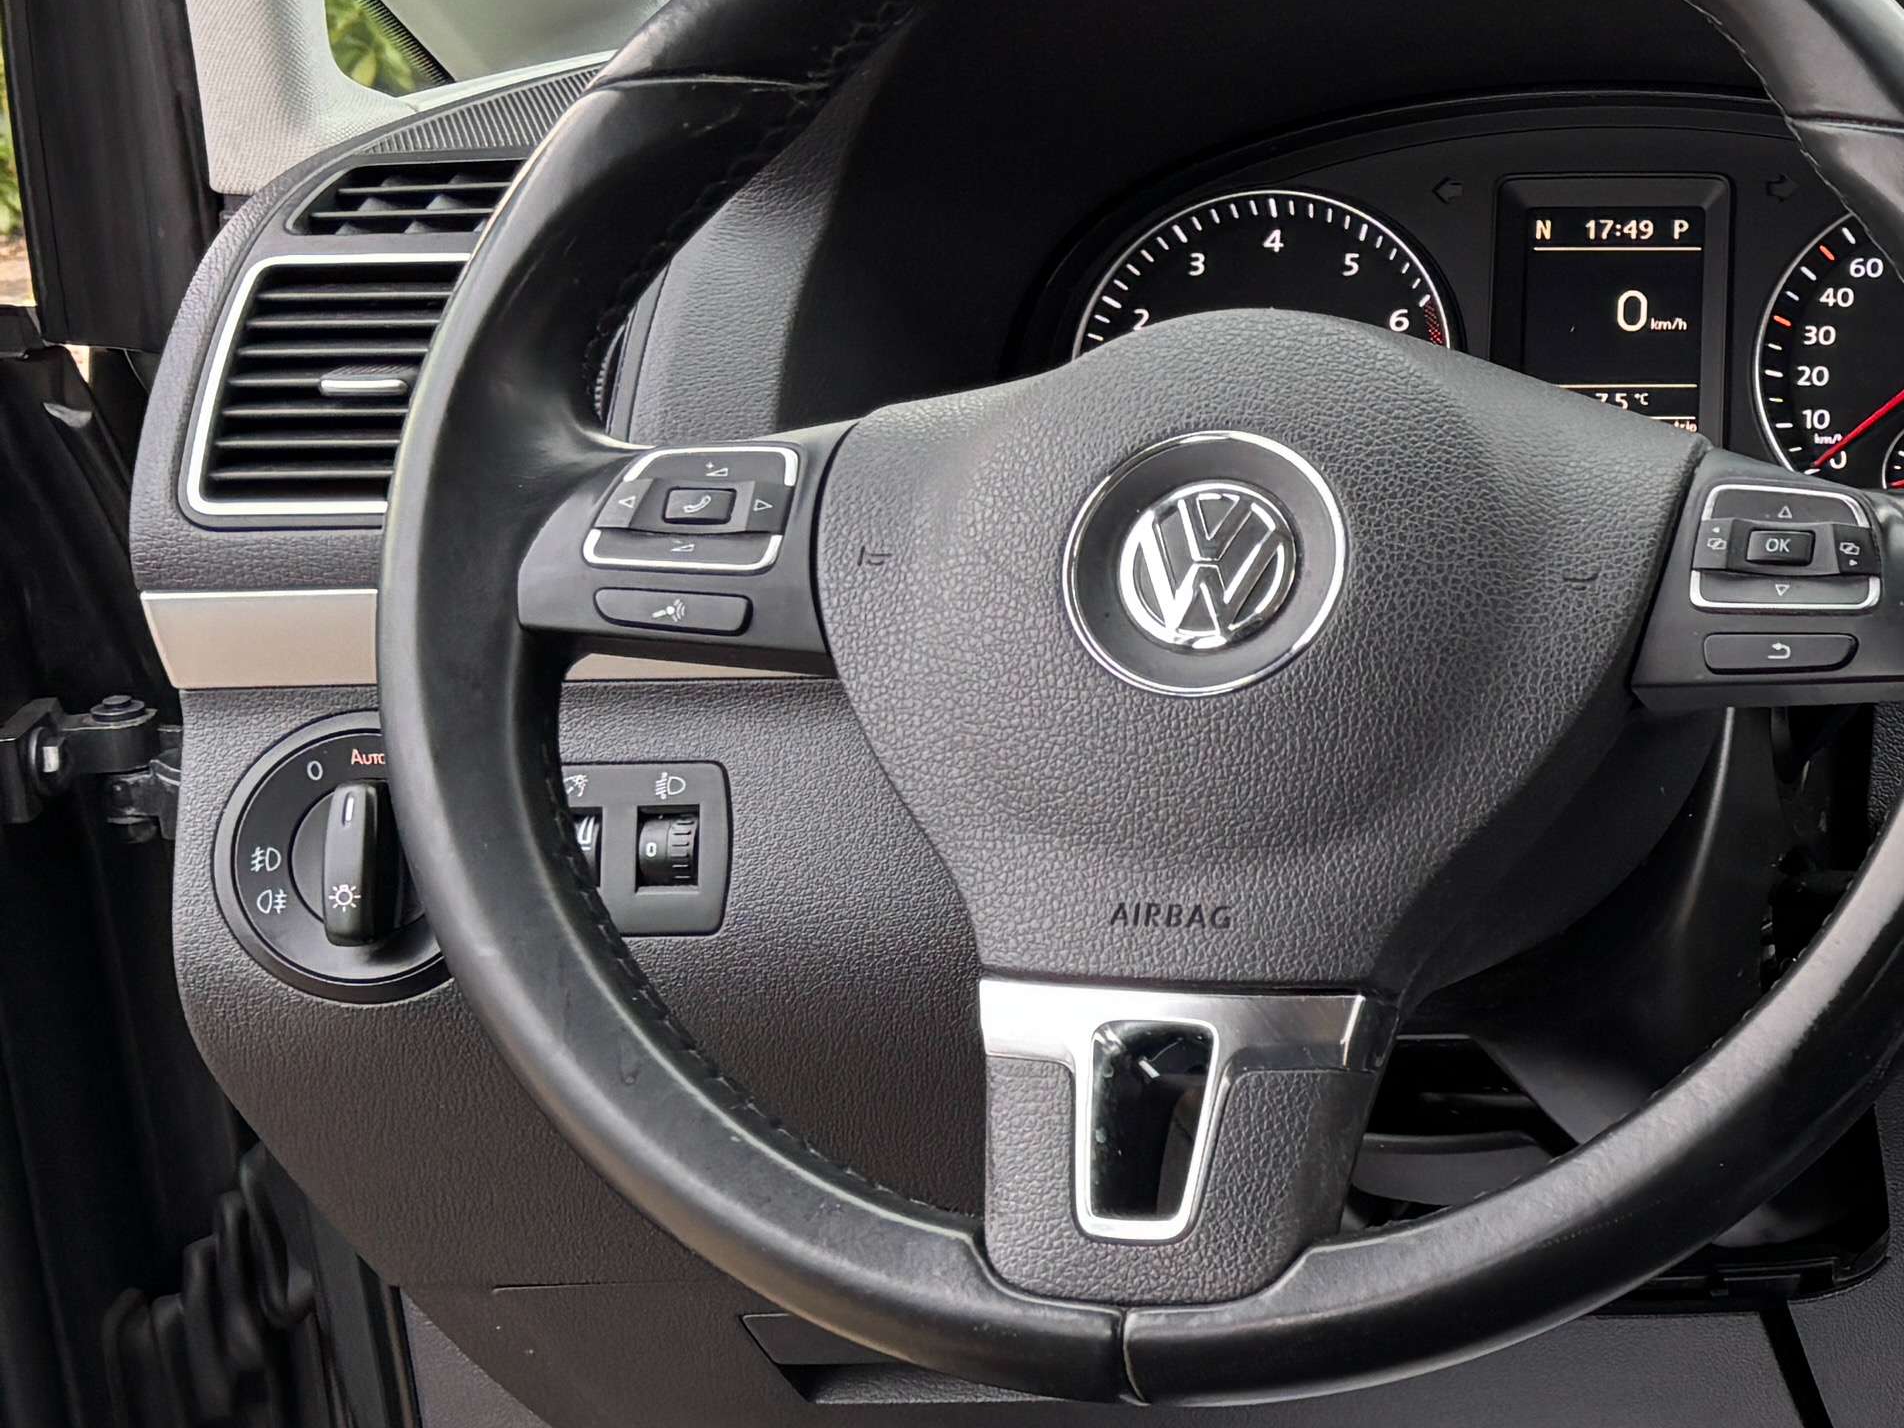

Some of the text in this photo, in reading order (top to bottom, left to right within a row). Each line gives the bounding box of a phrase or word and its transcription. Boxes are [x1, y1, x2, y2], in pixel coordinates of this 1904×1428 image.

[1262, 228, 1285, 253] 4
[1535, 219, 1690, 240] N 17:49 P
[1187, 252, 1206, 277] 3
[1341, 252, 1361, 277] 5
[1849, 257, 1884, 278] 60
[1819, 287, 1855, 308] 40
[1133, 308, 1150, 330] 2
[1388, 308, 1410, 332] 6
[1616, 289, 1688, 332] 0 km/h
[1803, 325, 1837, 346] 30
[1796, 365, 1830, 387] 20
[1802, 409, 1831, 430] 10
[1765, 538, 1791, 553] OK
[646, 843, 656, 858] 0
[1110, 901, 1233, 930] AIRBAG
